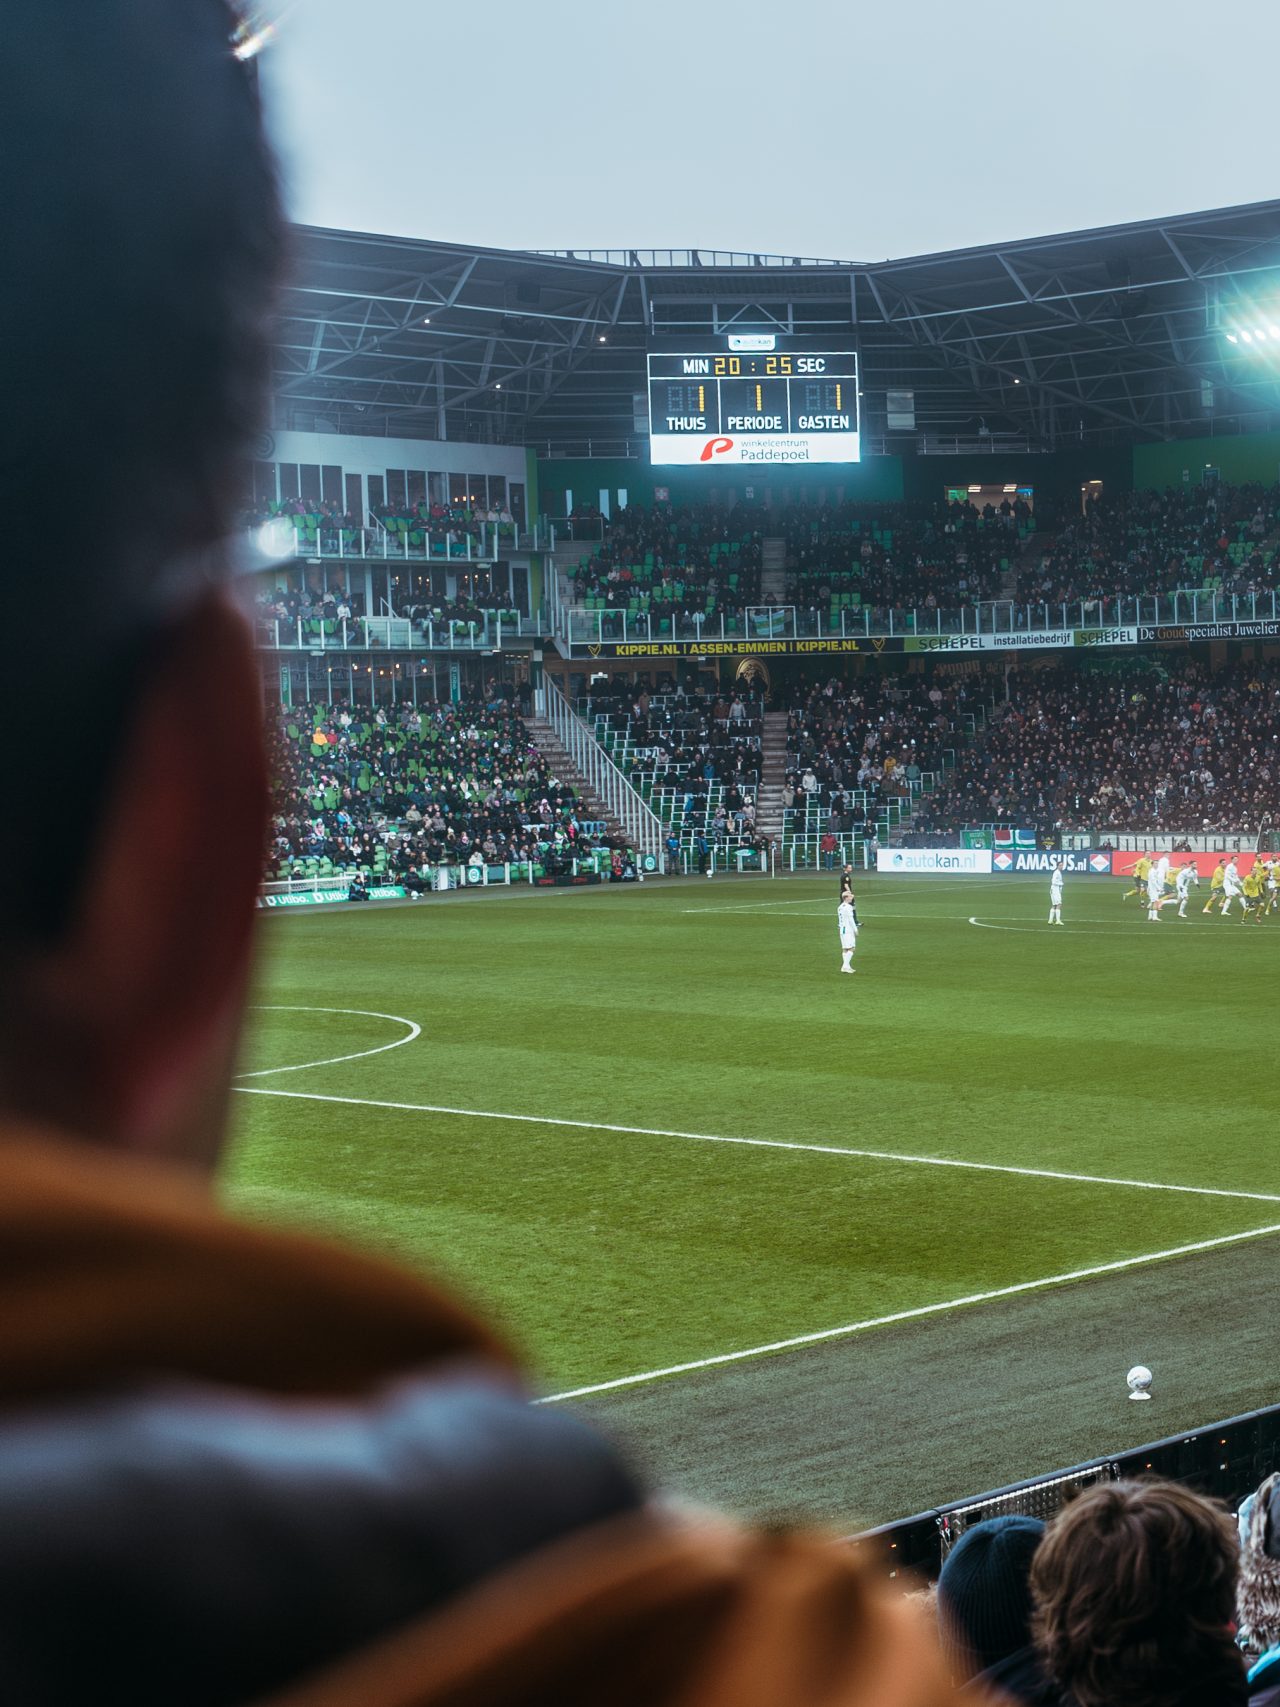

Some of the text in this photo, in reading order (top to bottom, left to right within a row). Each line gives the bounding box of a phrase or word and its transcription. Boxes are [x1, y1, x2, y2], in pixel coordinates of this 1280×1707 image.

[683, 359, 709, 374] MIN
[714, 357, 741, 375] 20
[766, 356, 792, 374] 25
[797, 358, 825, 372] SEC
[666, 417, 707, 431] THUIS
[728, 416, 783, 430] PERIODE
[798, 415, 849, 429] GASTEN
[741, 438, 809, 447] winkelcentrum
[741, 448, 809, 461] Paddepoel
[1080, 630, 1134, 644] SCHEPEL
[1140, 628, 1155, 640] De
[1157, 624, 1232, 641] Goudspecialist
[1234, 622, 1280, 636] Juwelier
[616, 639, 859, 656] KIPPIE.NL ASSEN-EMMEN KIPPIE.NL
[918, 632, 1072, 650] SCHEPEL installatiebedrijf
[905, 853, 976, 868] autokan.nl
[1015, 853, 1087, 871] AMASUS.nl
